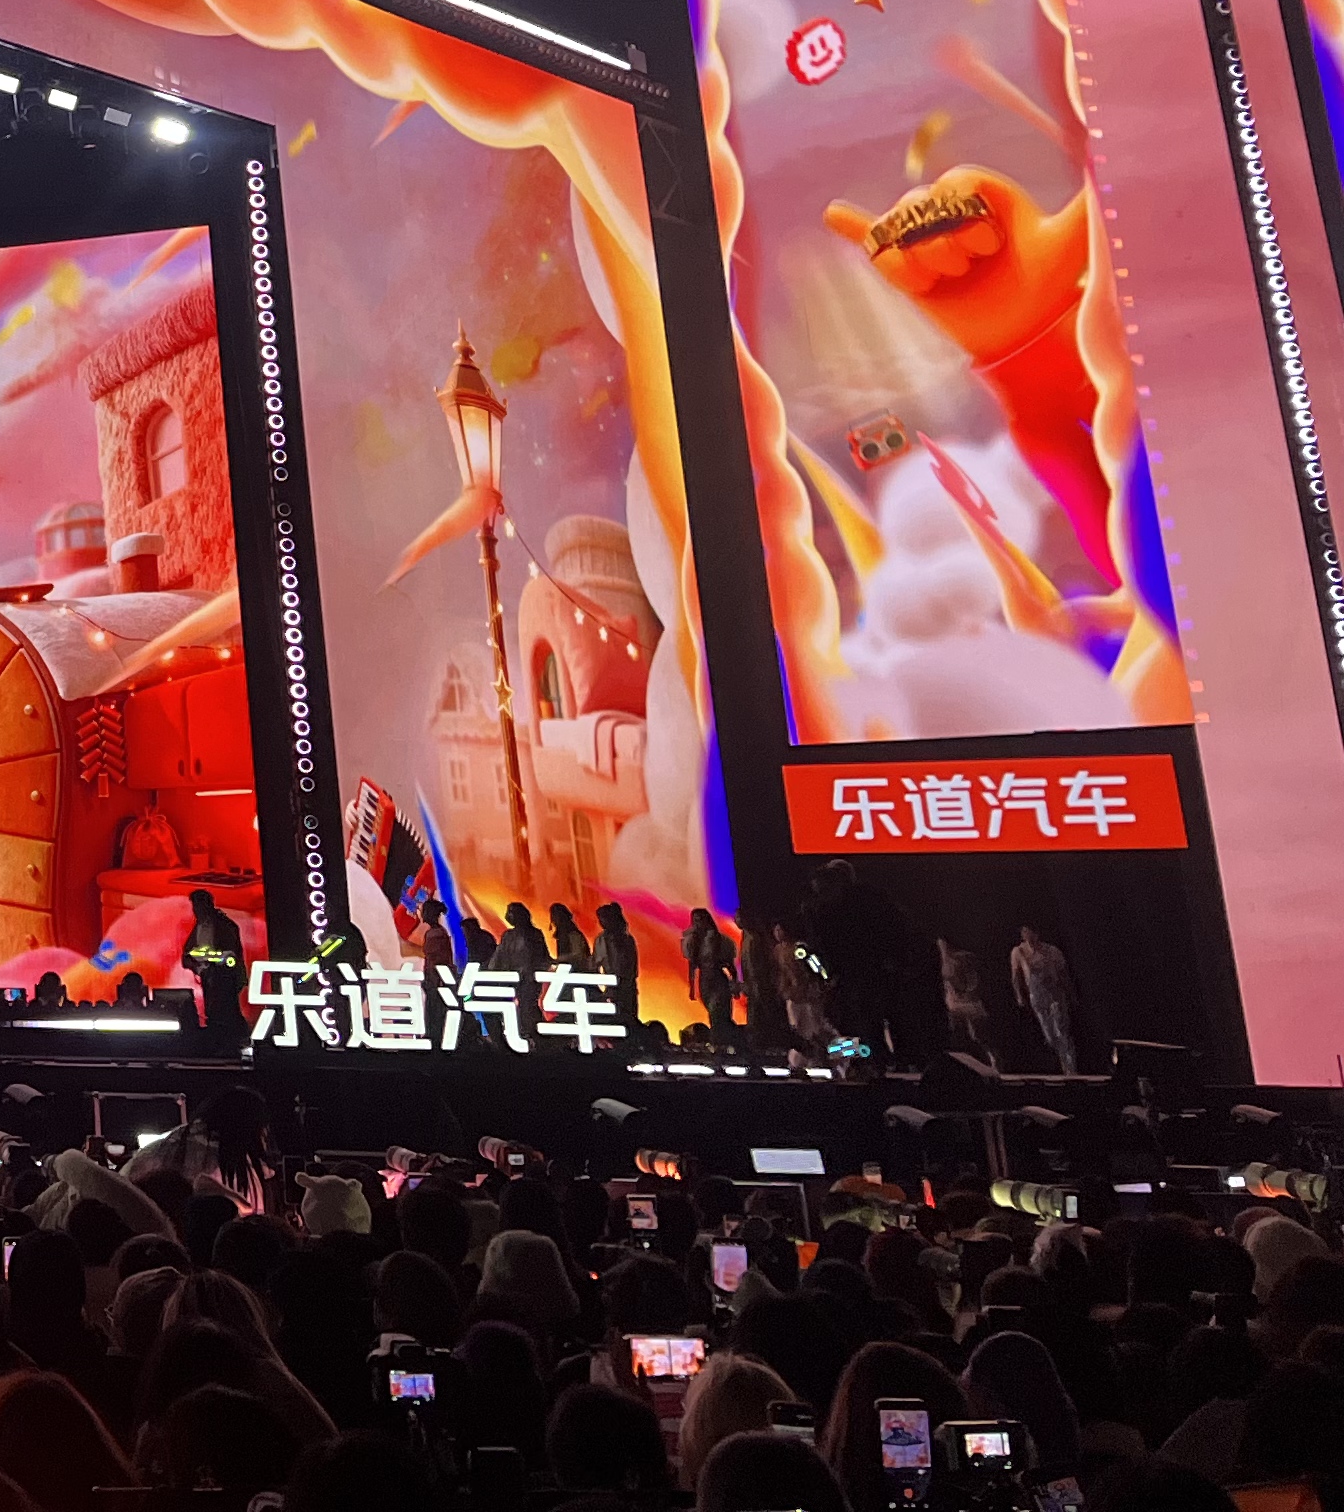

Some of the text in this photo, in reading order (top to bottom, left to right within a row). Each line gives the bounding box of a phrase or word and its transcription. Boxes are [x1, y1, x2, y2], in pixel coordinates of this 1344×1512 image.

[833, 770, 1136, 840] 乐道汽车
[247, 961, 628, 1054] 乐道汽车
